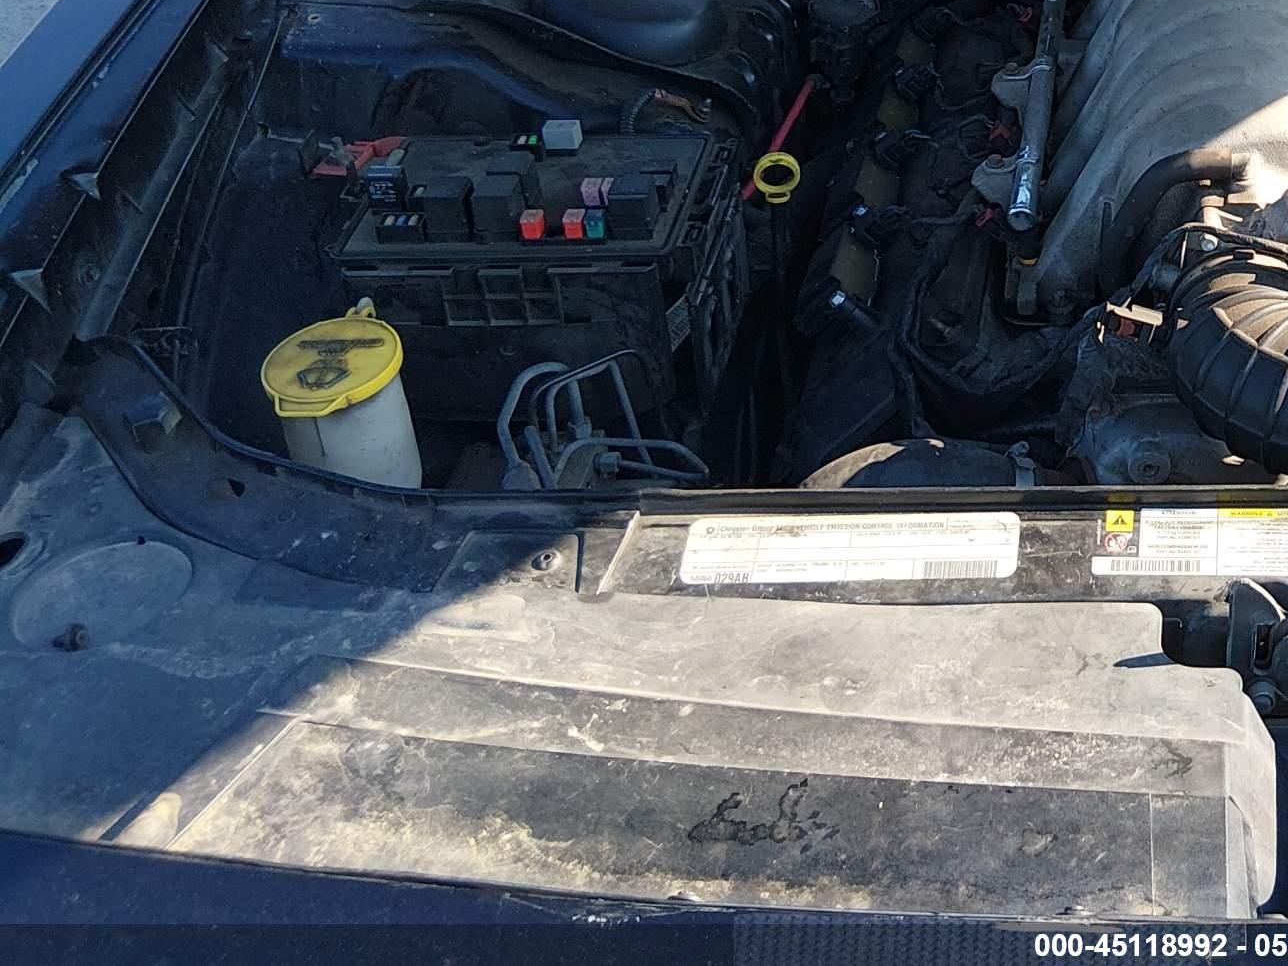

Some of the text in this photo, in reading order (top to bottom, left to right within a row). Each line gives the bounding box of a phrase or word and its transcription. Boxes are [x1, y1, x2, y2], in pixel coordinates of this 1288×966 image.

[720, 524, 750, 534] Chrysler
[826, 522, 861, 531] EMISSION
[862, 521, 893, 530] CONTROL
[897, 520, 945, 530] INFORMATION
[714, 572, 750, 585] 029AB
